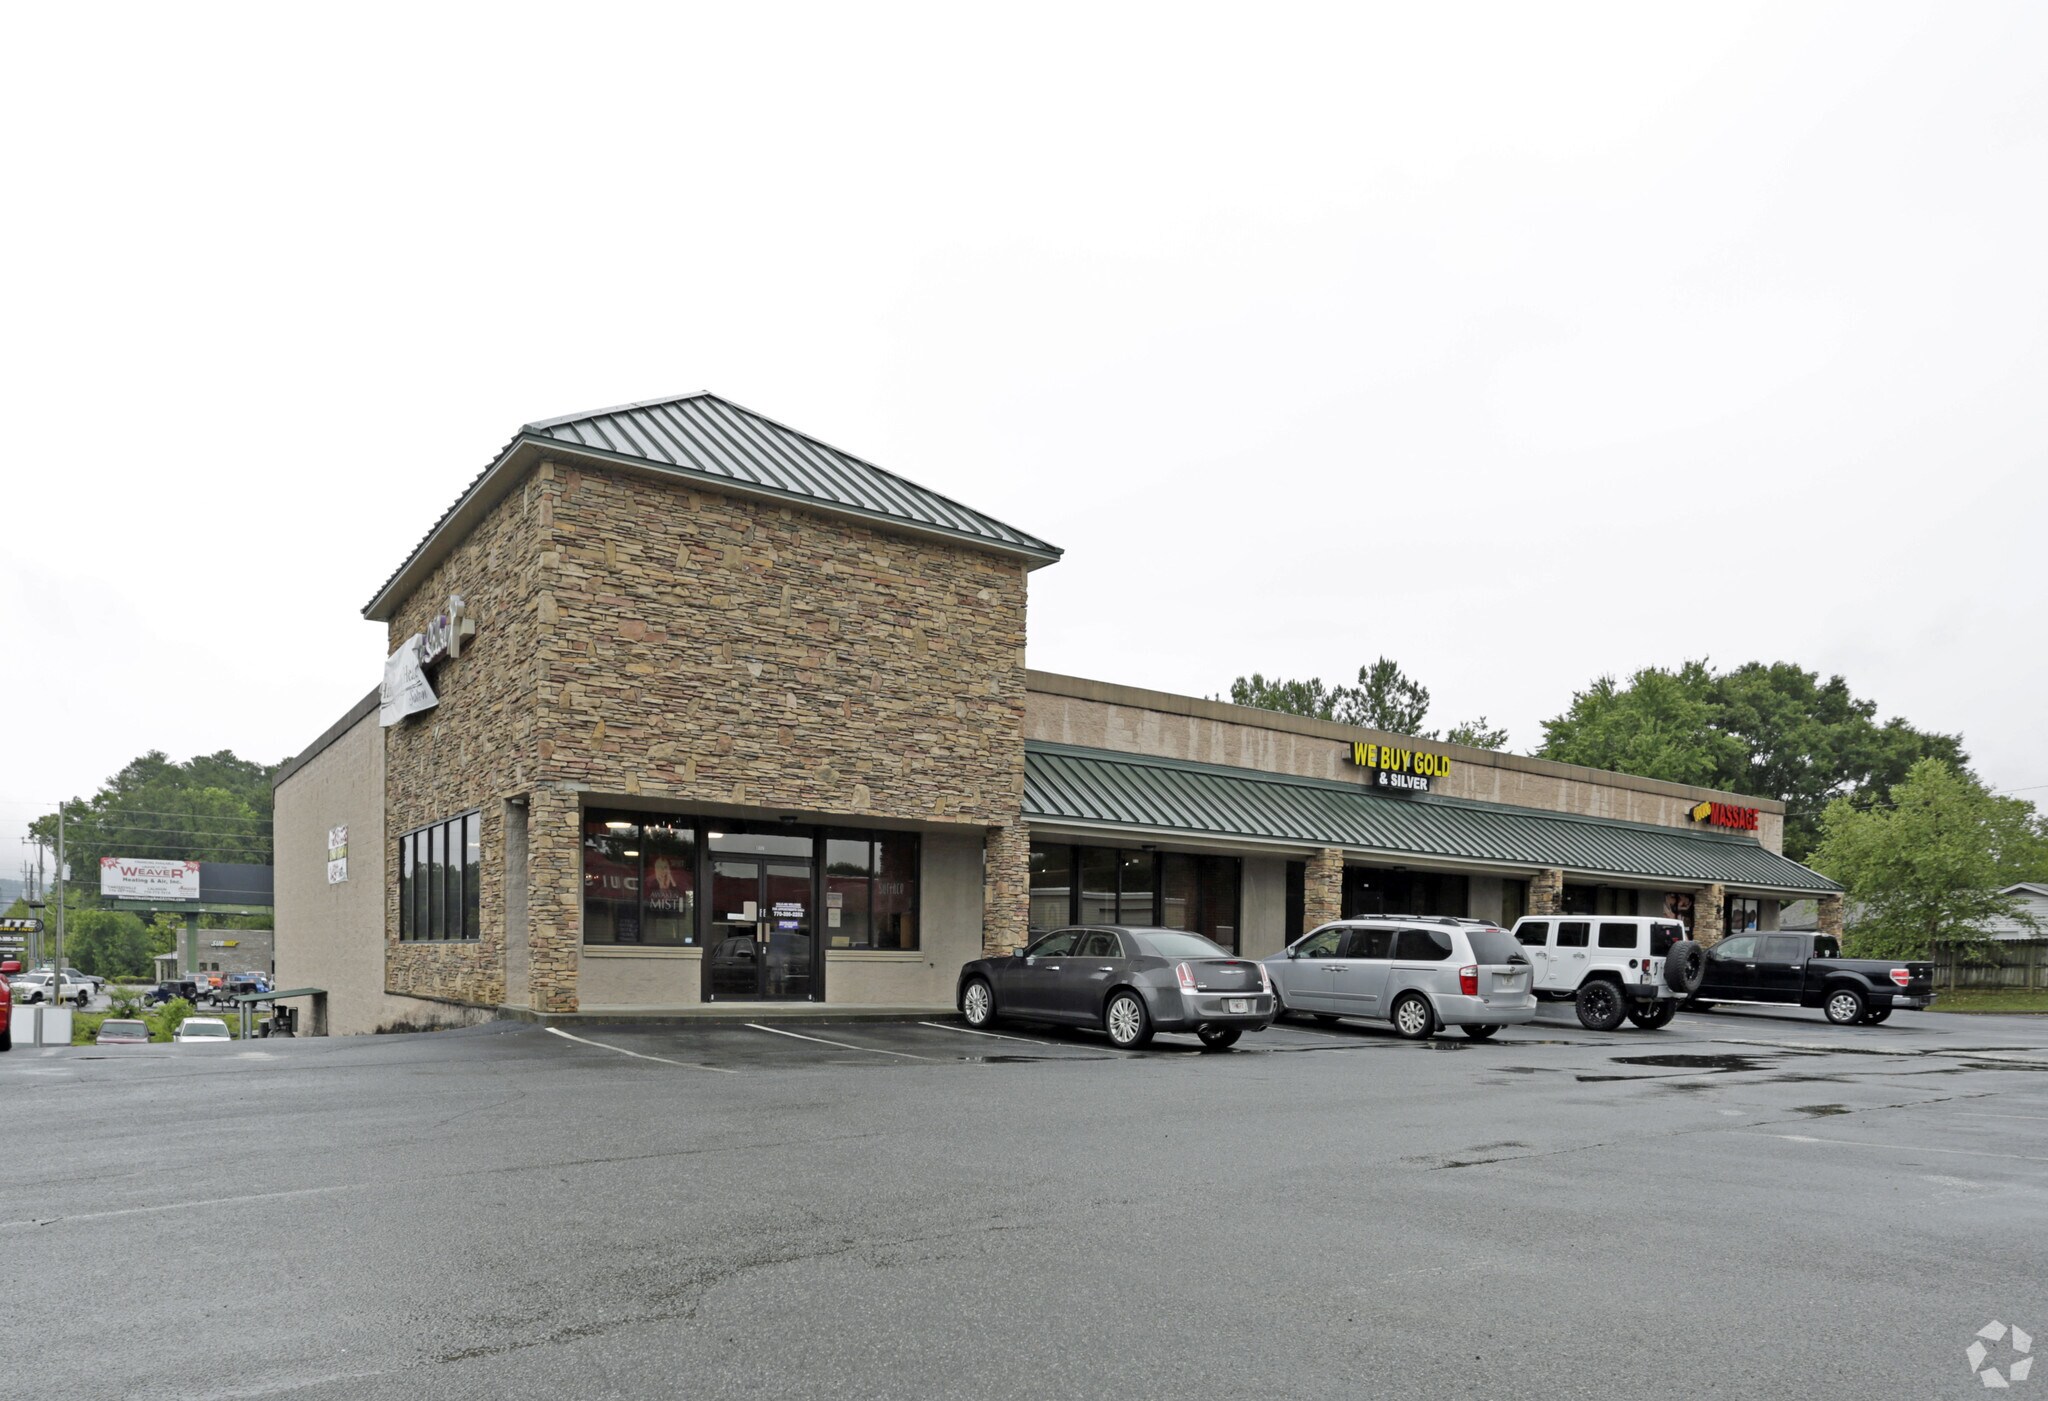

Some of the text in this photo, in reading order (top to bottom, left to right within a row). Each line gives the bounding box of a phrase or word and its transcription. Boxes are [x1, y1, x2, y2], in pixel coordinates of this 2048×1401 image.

[1354, 741, 1451, 778] WE BUY GOLD
[1379, 772, 1428, 791] & SILVER
[1711, 802, 1759, 831] MASSAGE
